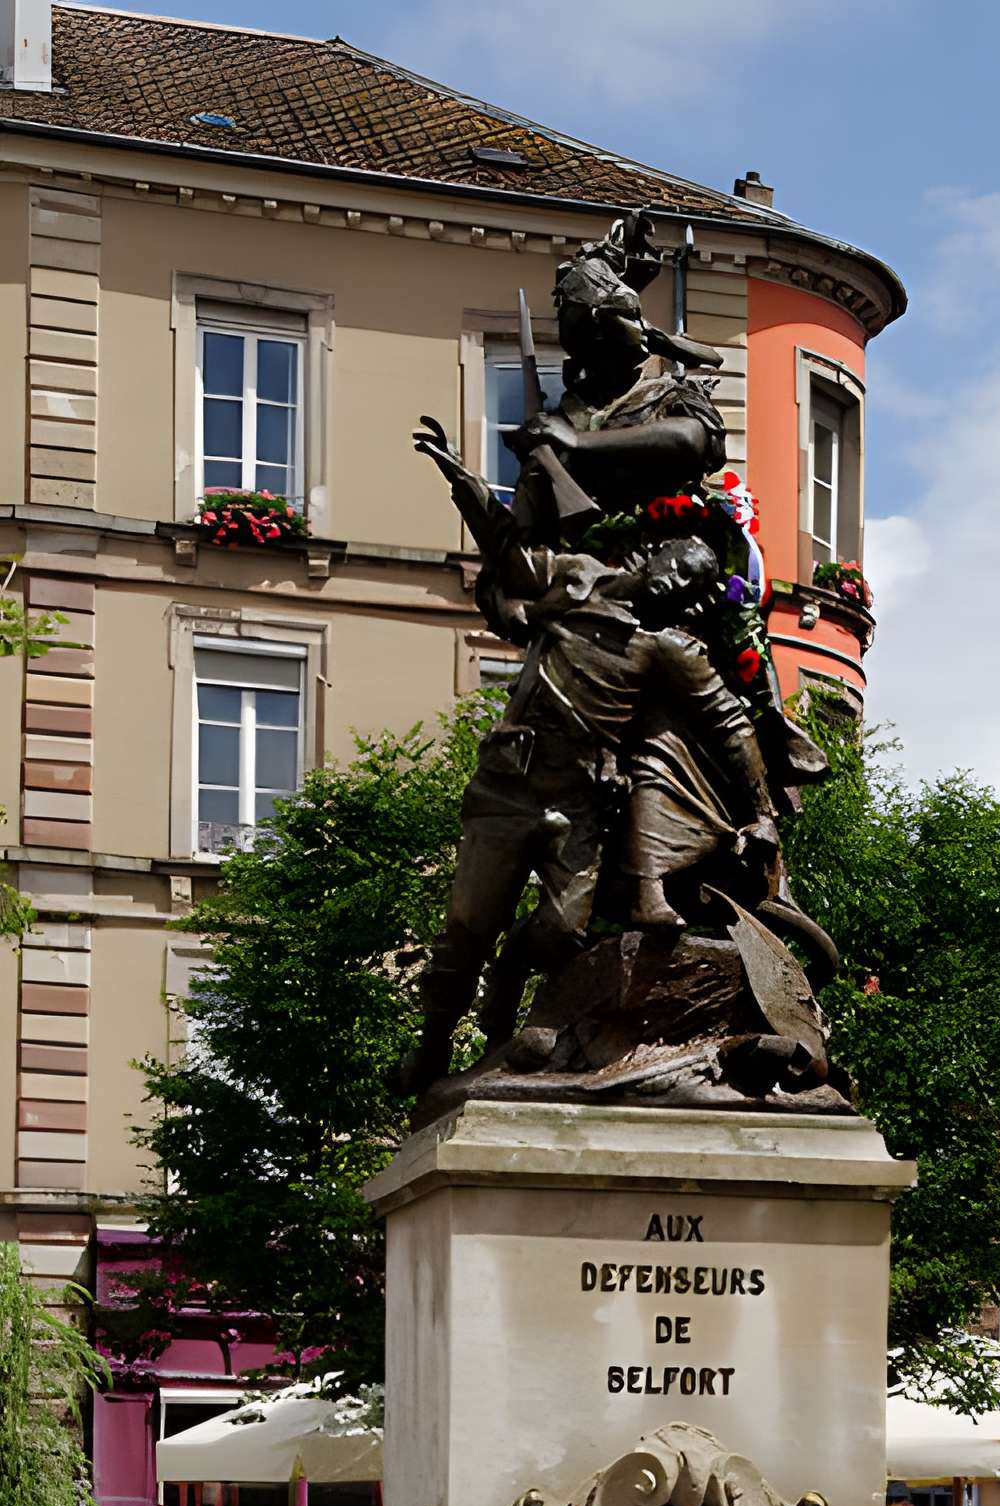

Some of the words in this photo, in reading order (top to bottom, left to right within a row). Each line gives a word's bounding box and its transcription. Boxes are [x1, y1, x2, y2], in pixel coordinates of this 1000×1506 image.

[643, 1213, 704, 1242] AUX
[580, 1261, 765, 1295] DEFENSEURS
[655, 1316, 691, 1344] DE
[607, 1365, 736, 1395] BELFORT
